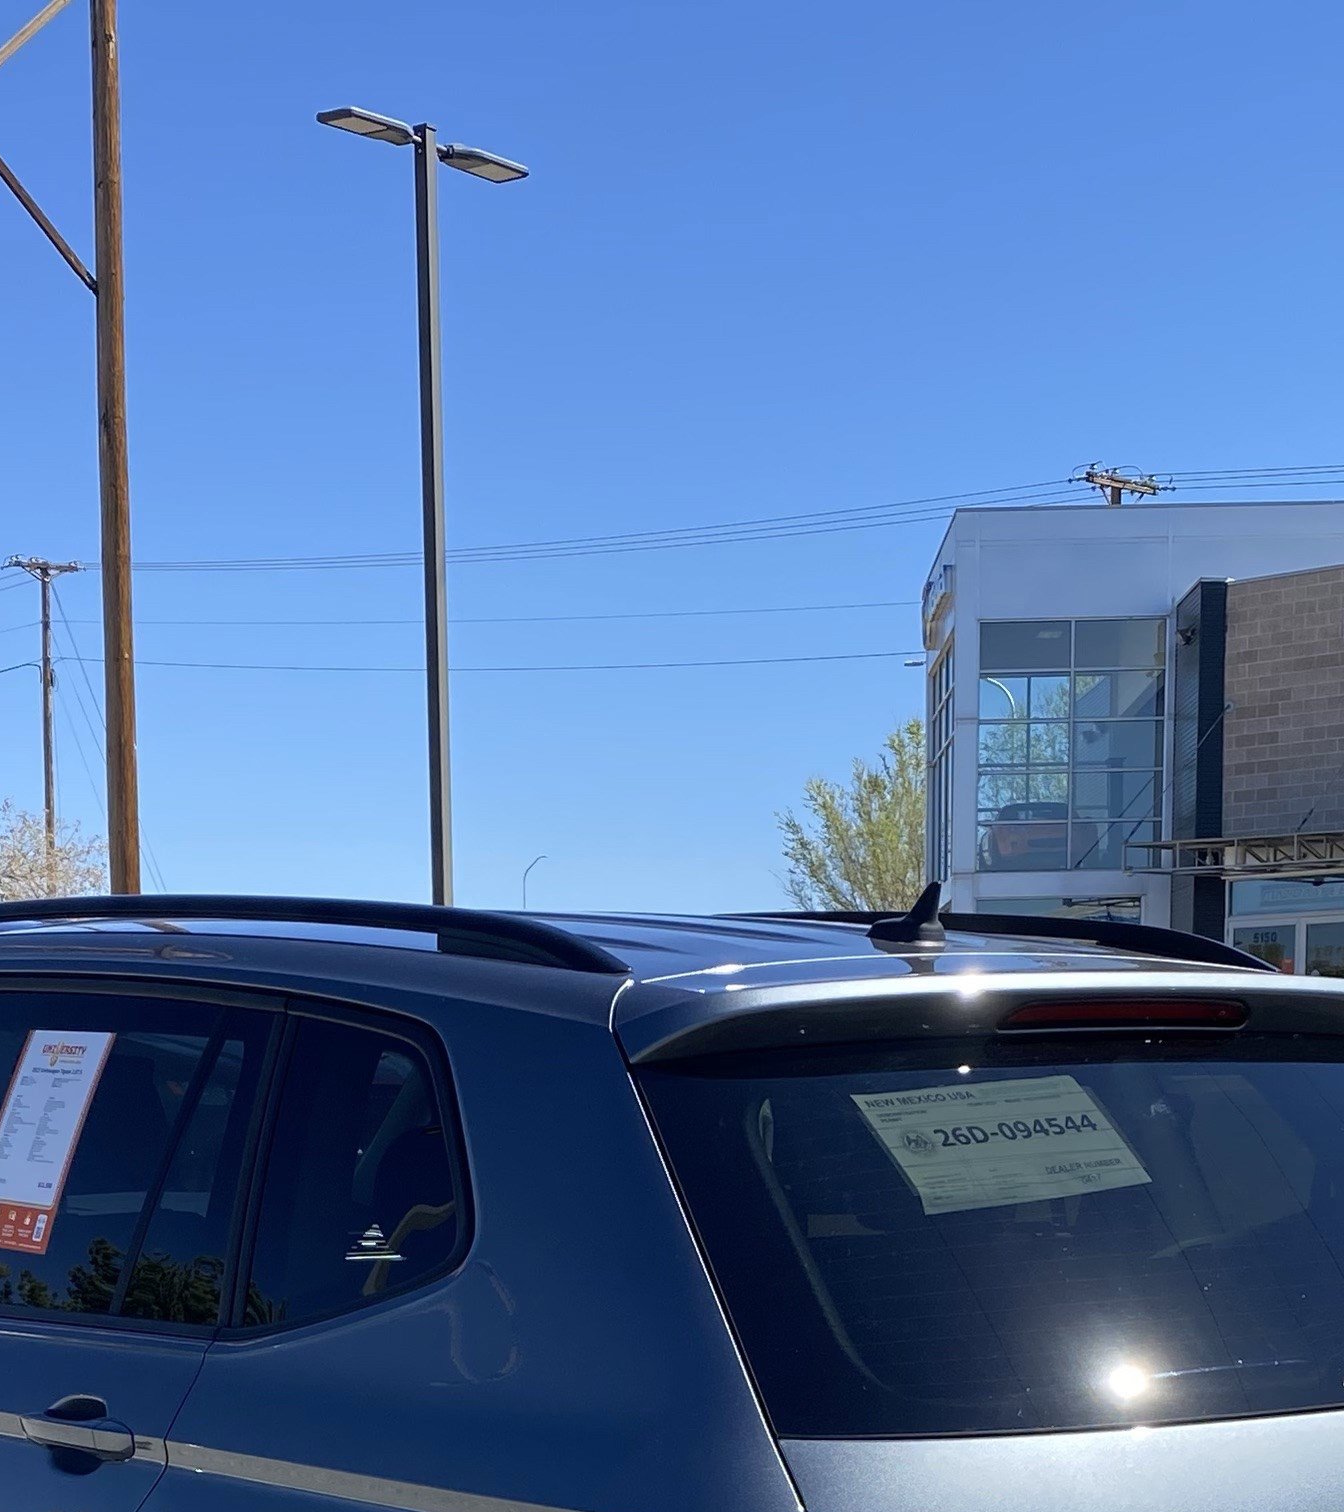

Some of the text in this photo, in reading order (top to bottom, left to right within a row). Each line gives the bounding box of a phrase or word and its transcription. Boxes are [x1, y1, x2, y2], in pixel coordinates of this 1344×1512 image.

[864, 1089, 976, 1109] NEW MEXICO USA
[933, 1113, 1098, 1148] 26D-094544
[1044, 1161, 1083, 1175] DEALER
